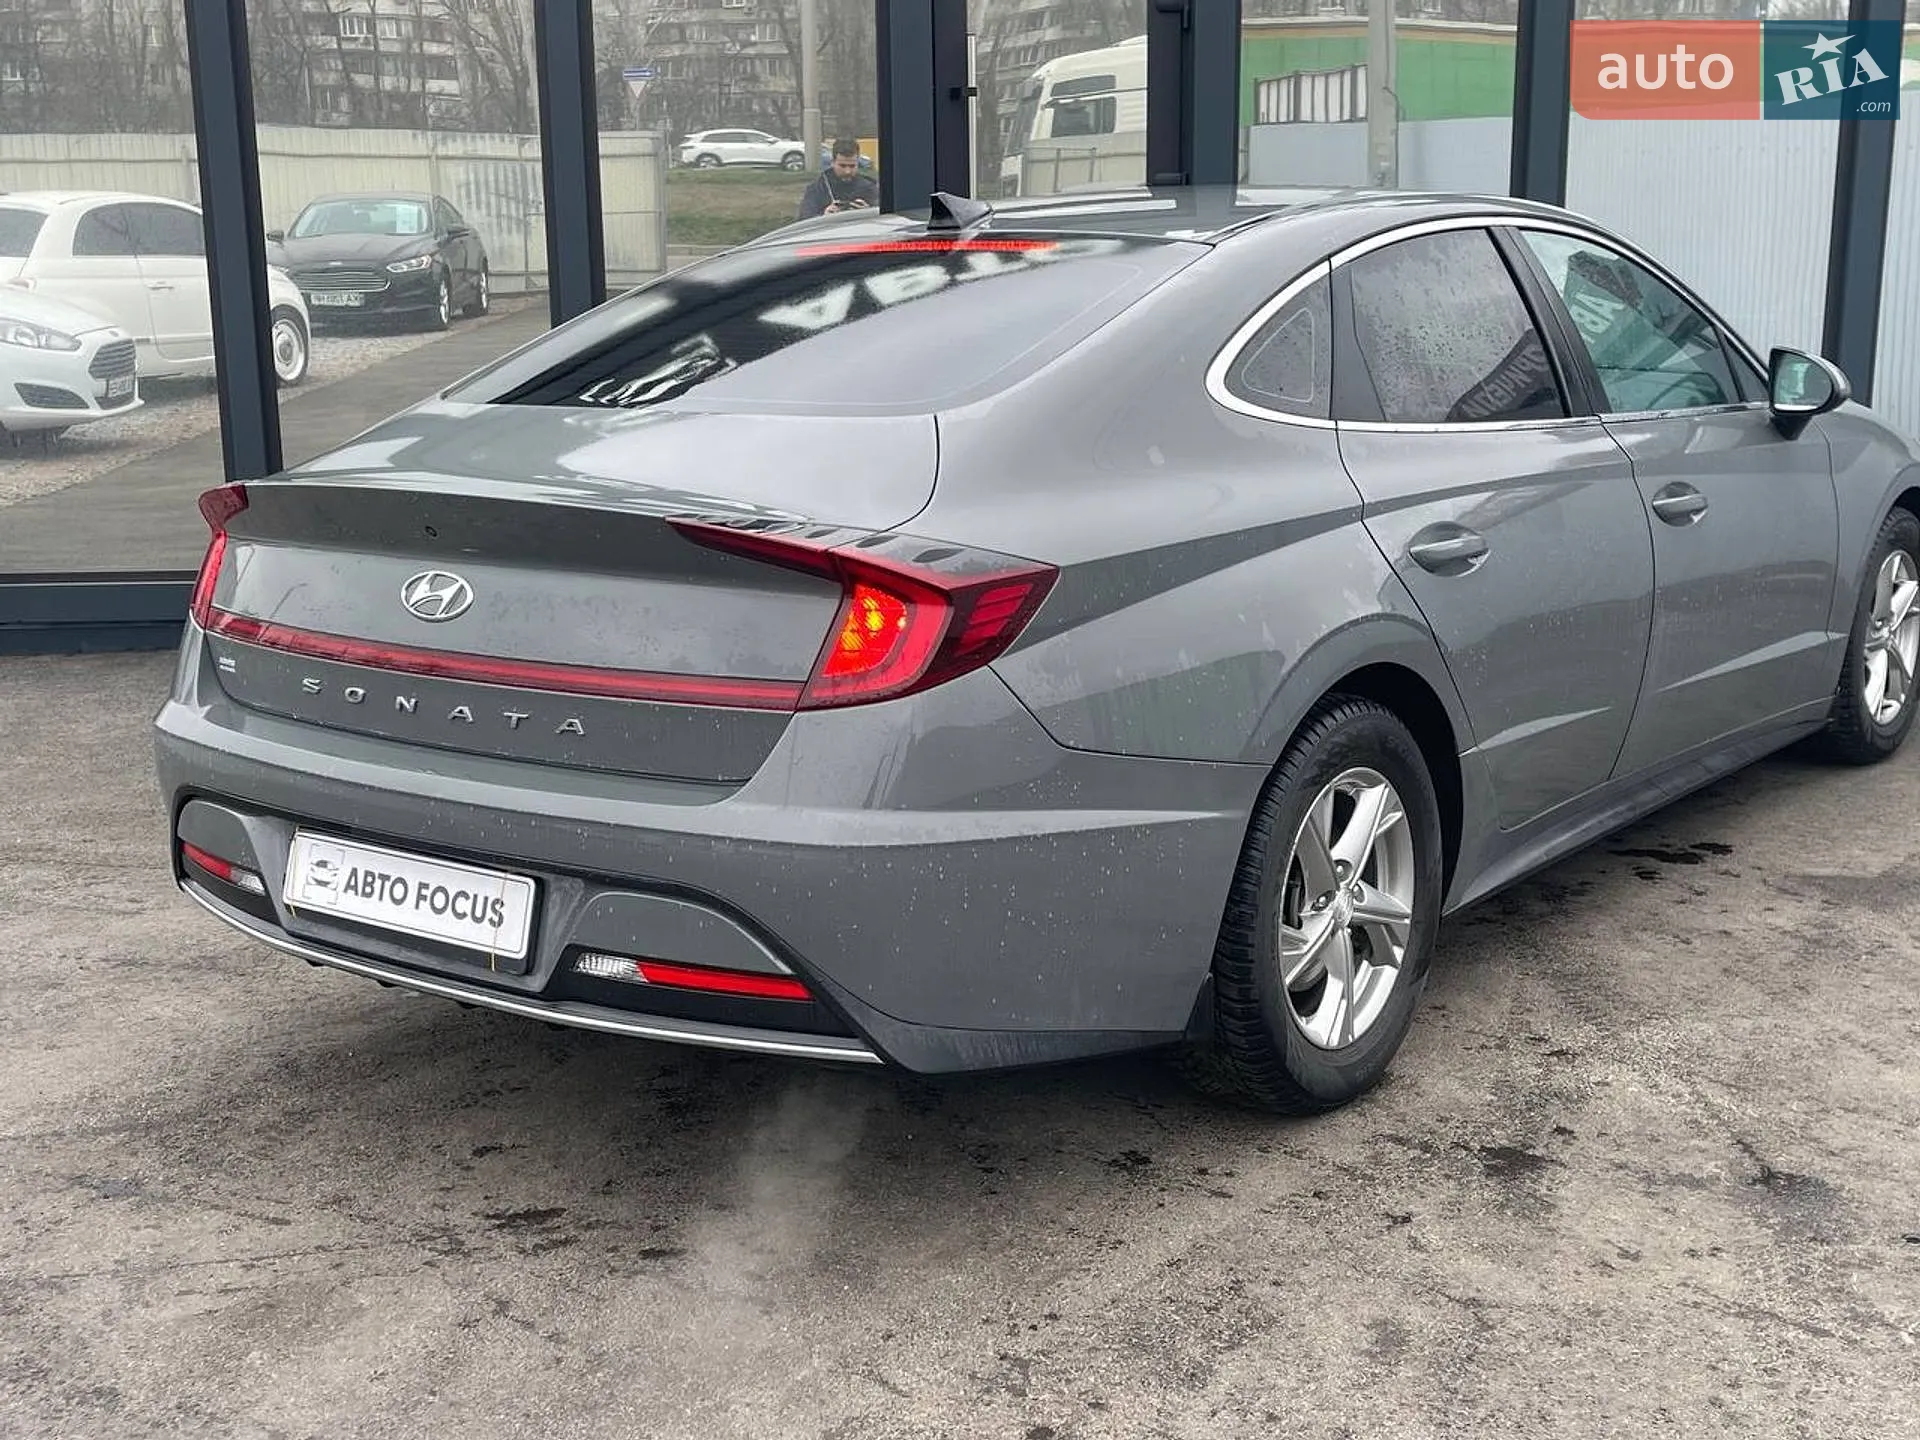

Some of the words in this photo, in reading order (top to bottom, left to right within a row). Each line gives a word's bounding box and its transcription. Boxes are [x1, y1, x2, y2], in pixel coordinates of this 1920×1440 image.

[301, 676, 586, 736] SONATA
[343, 867, 409, 906] АВТО
[414, 880, 505, 928] FOCUS
